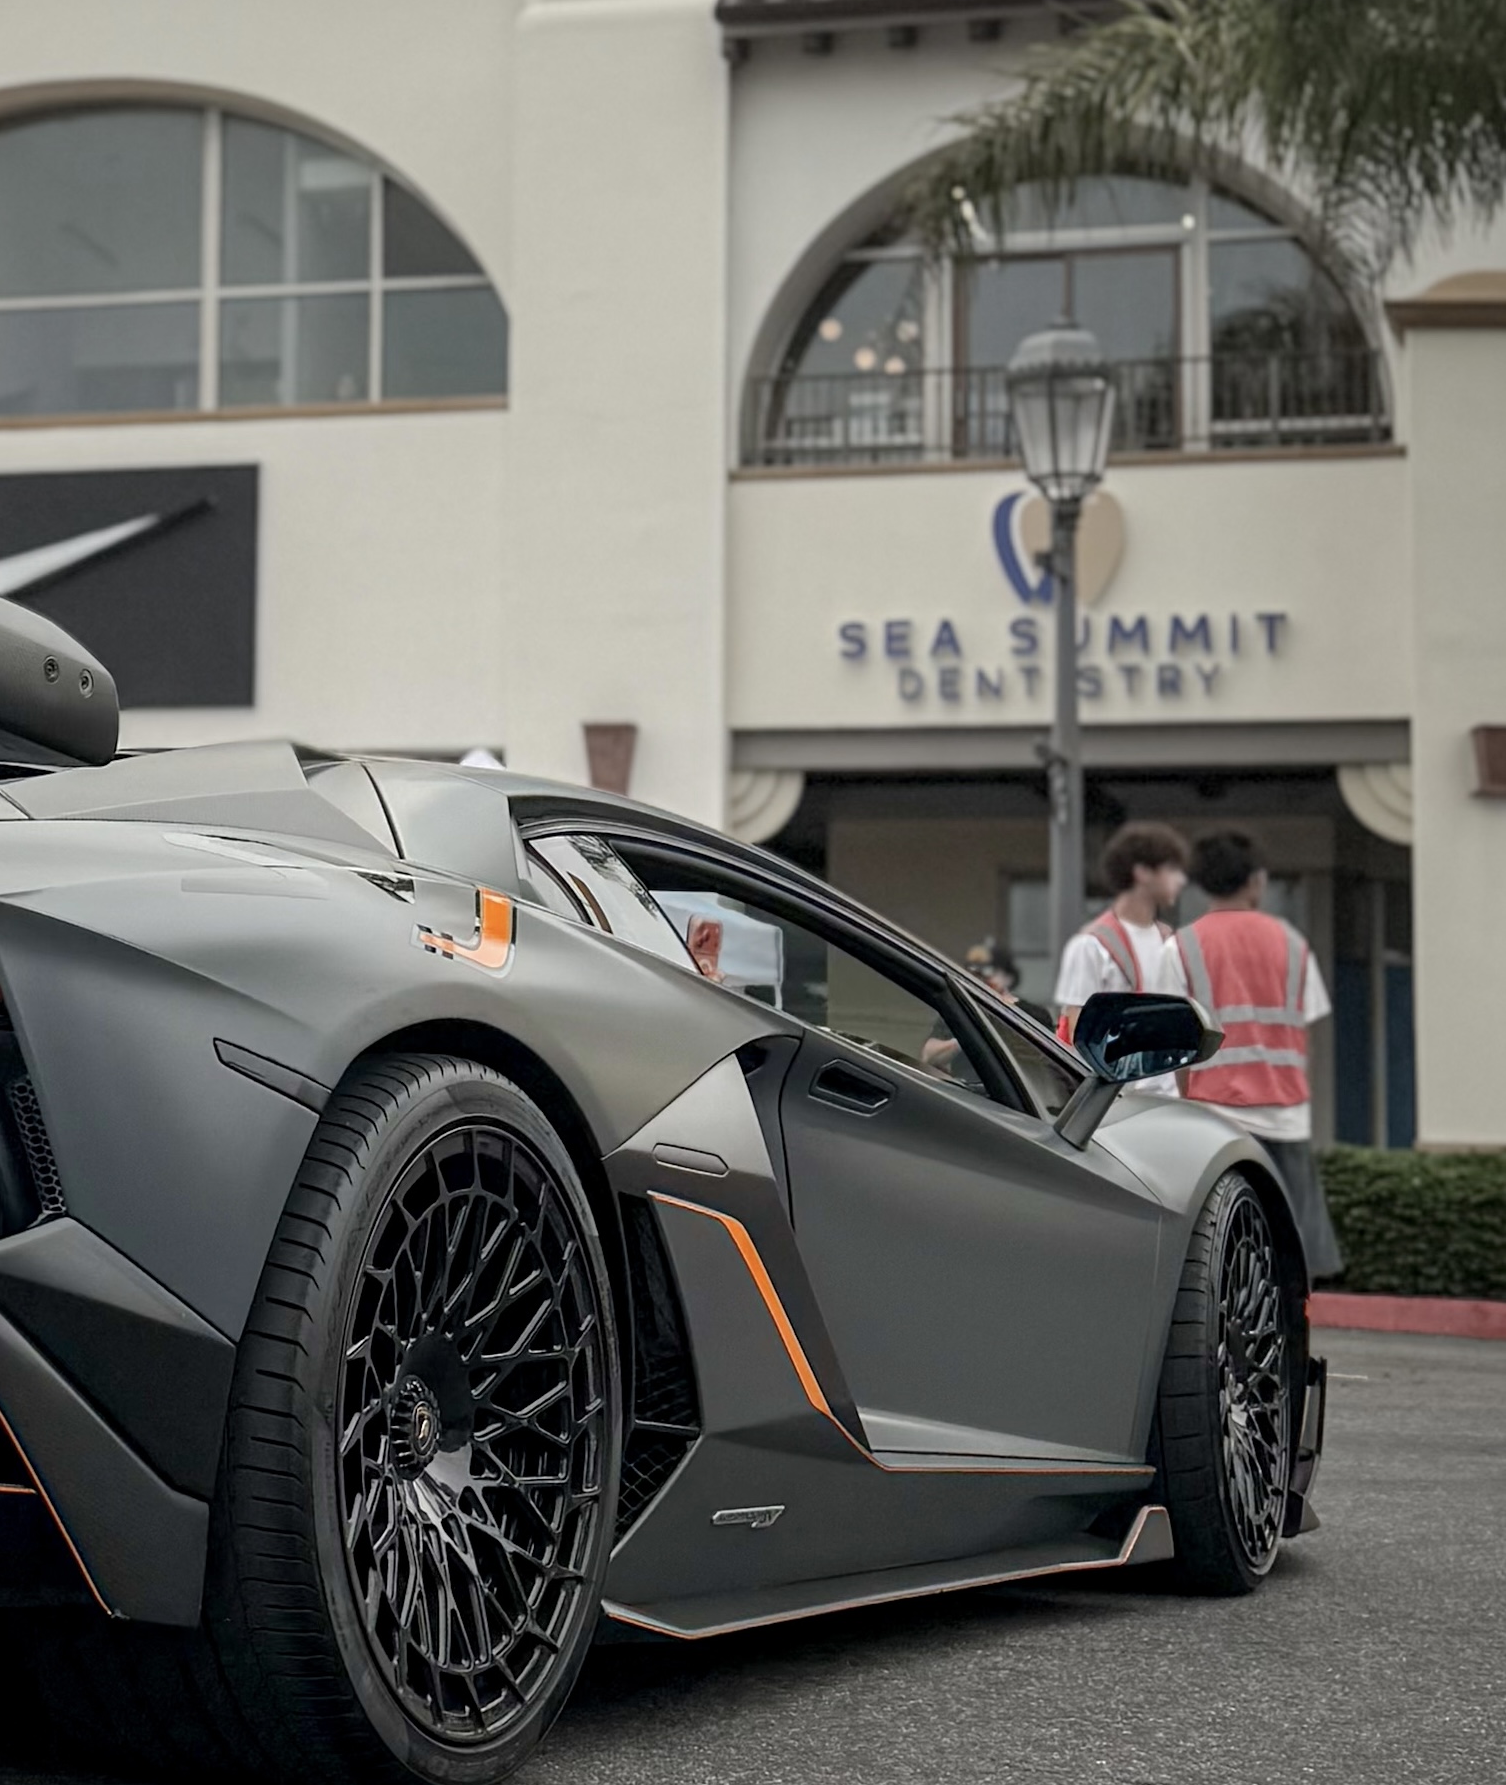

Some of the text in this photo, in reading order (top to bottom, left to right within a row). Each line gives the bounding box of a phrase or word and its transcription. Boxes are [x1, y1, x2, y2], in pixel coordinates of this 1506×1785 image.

[838, 614, 1288, 661] SEA SUMMIT
[899, 664, 1222, 702] DENTSTRY
